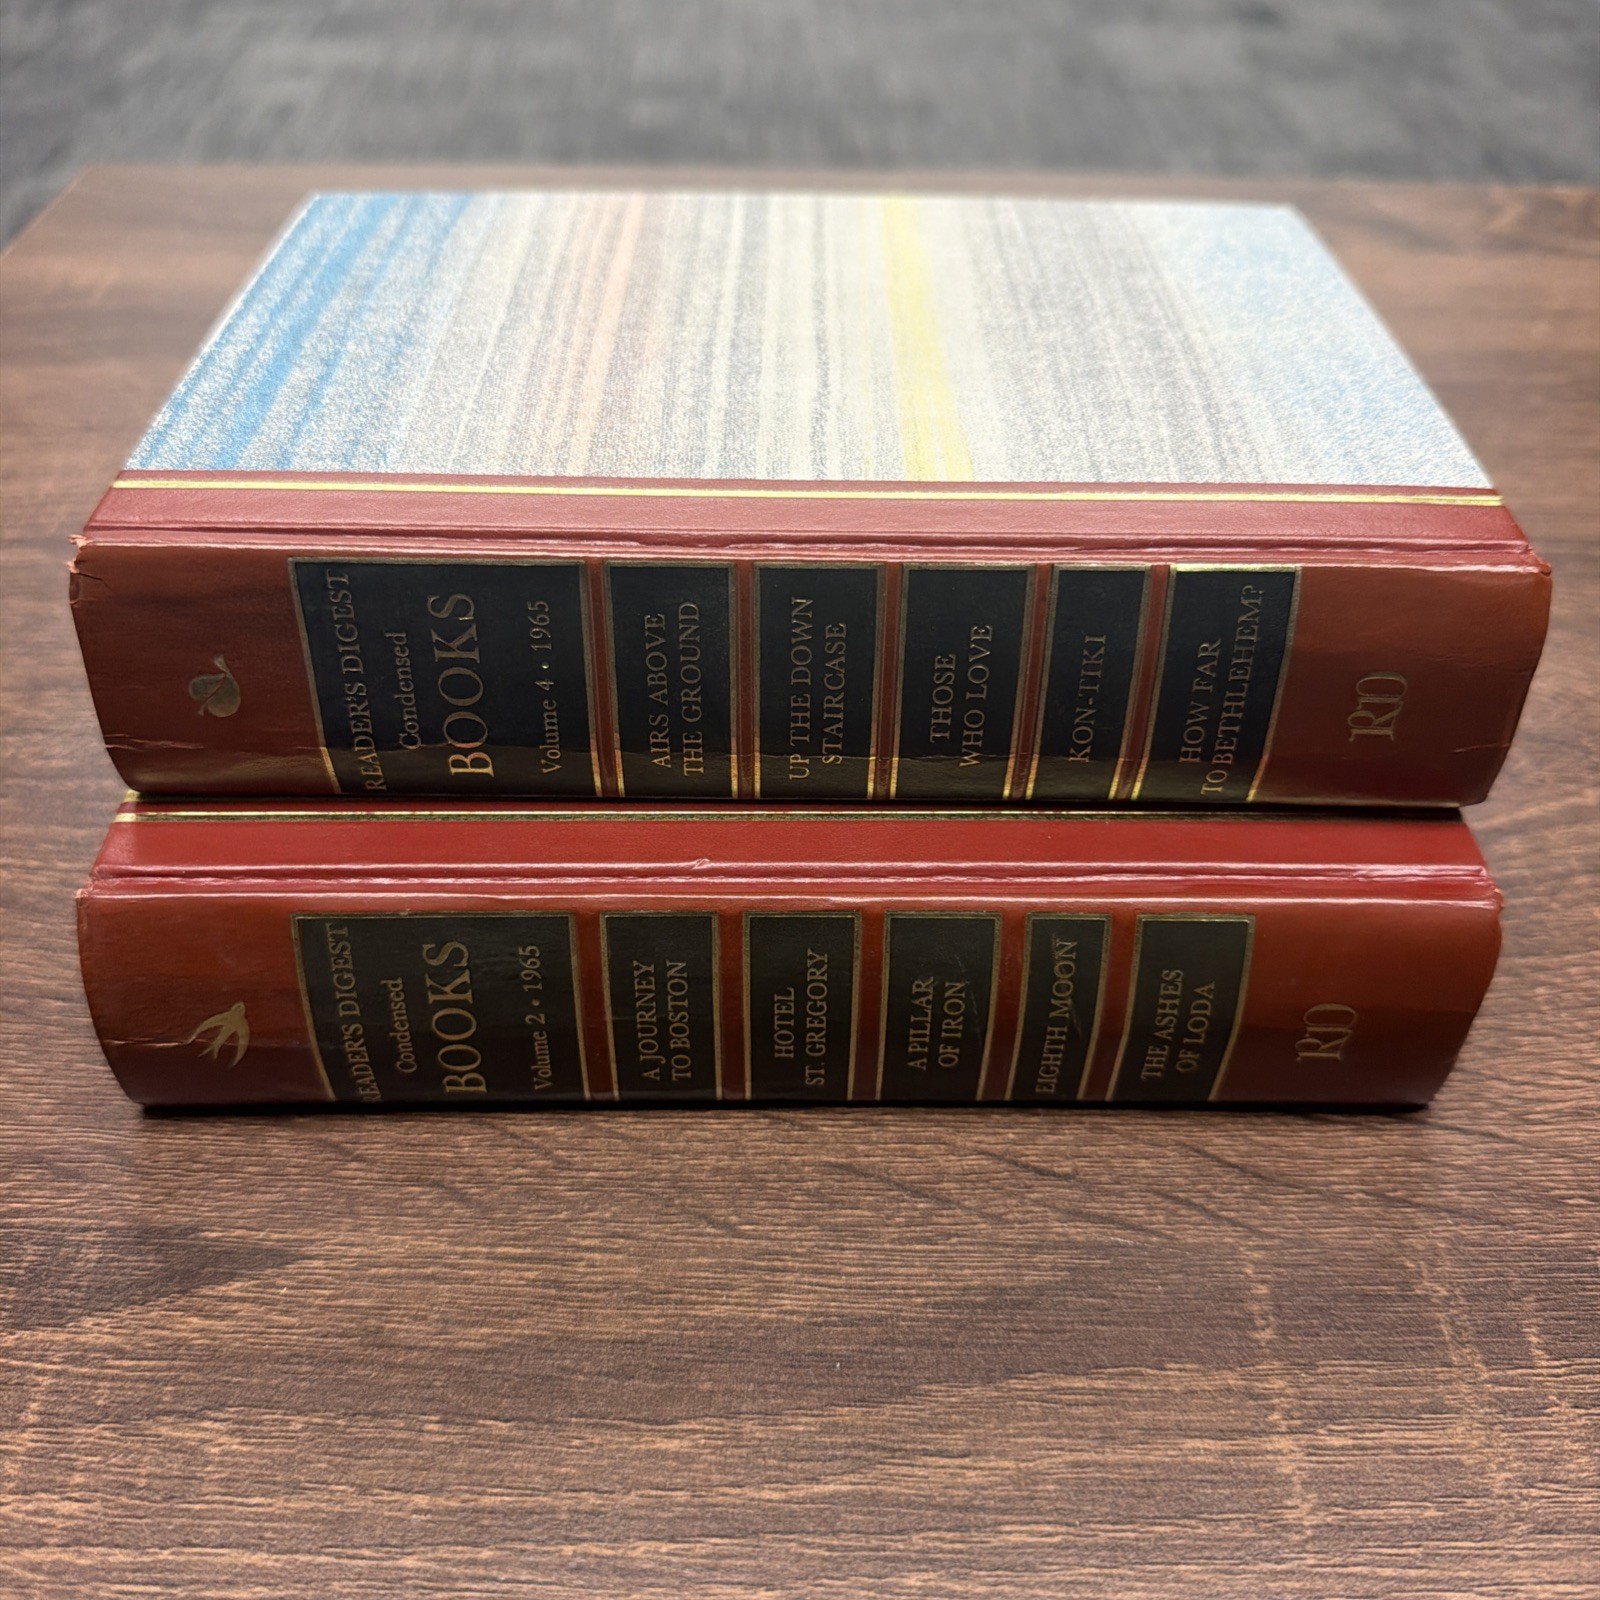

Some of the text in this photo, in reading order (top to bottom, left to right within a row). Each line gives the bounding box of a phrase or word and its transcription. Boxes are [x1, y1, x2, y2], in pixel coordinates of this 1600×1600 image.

[326, 568, 388, 791] READER'S DIGEST
[385, 631, 422, 750] Condensed
[427, 593, 495, 777] BOOKS
[527, 600, 562, 774] Volume 4 1965
[644, 613, 671, 768] AIRS ABOVE
[678, 601, 704, 776] THE GROUND
[789, 597, 814, 780] UP THE DOWN
[822, 622, 847, 765] STAIRCASE
[930, 653, 956, 743] THOSE
[959, 625, 993, 768] WHO LOVE
[1069, 634, 1106, 764] KON-TIKI
[1178, 638, 1222, 763] HOW FAR
[1201, 584, 1265, 795] TO BETHLEHEM?
[325, 923, 361, 1017] DIGEST
[380, 977, 417, 1073] Condensed
[422, 941, 488, 1094] BOOKS
[518, 944, 552, 1091] Volume 2 1965
[633, 960, 666, 1081] A JOURNEY
[666, 959, 692, 1081] TO BOSTON
[774, 986, 795, 1059] HOTEL
[805, 948, 828, 1086] ST. GREGORY
[906, 976, 934, 1071] A PILLAR
[938, 981, 966, 1068] OF IRON
[1035, 934, 1078, 1093] EIGHTH MOON
[1140, 969, 1184, 1080] THE ASHES
[1176, 981, 1216, 1073] OF LODA
